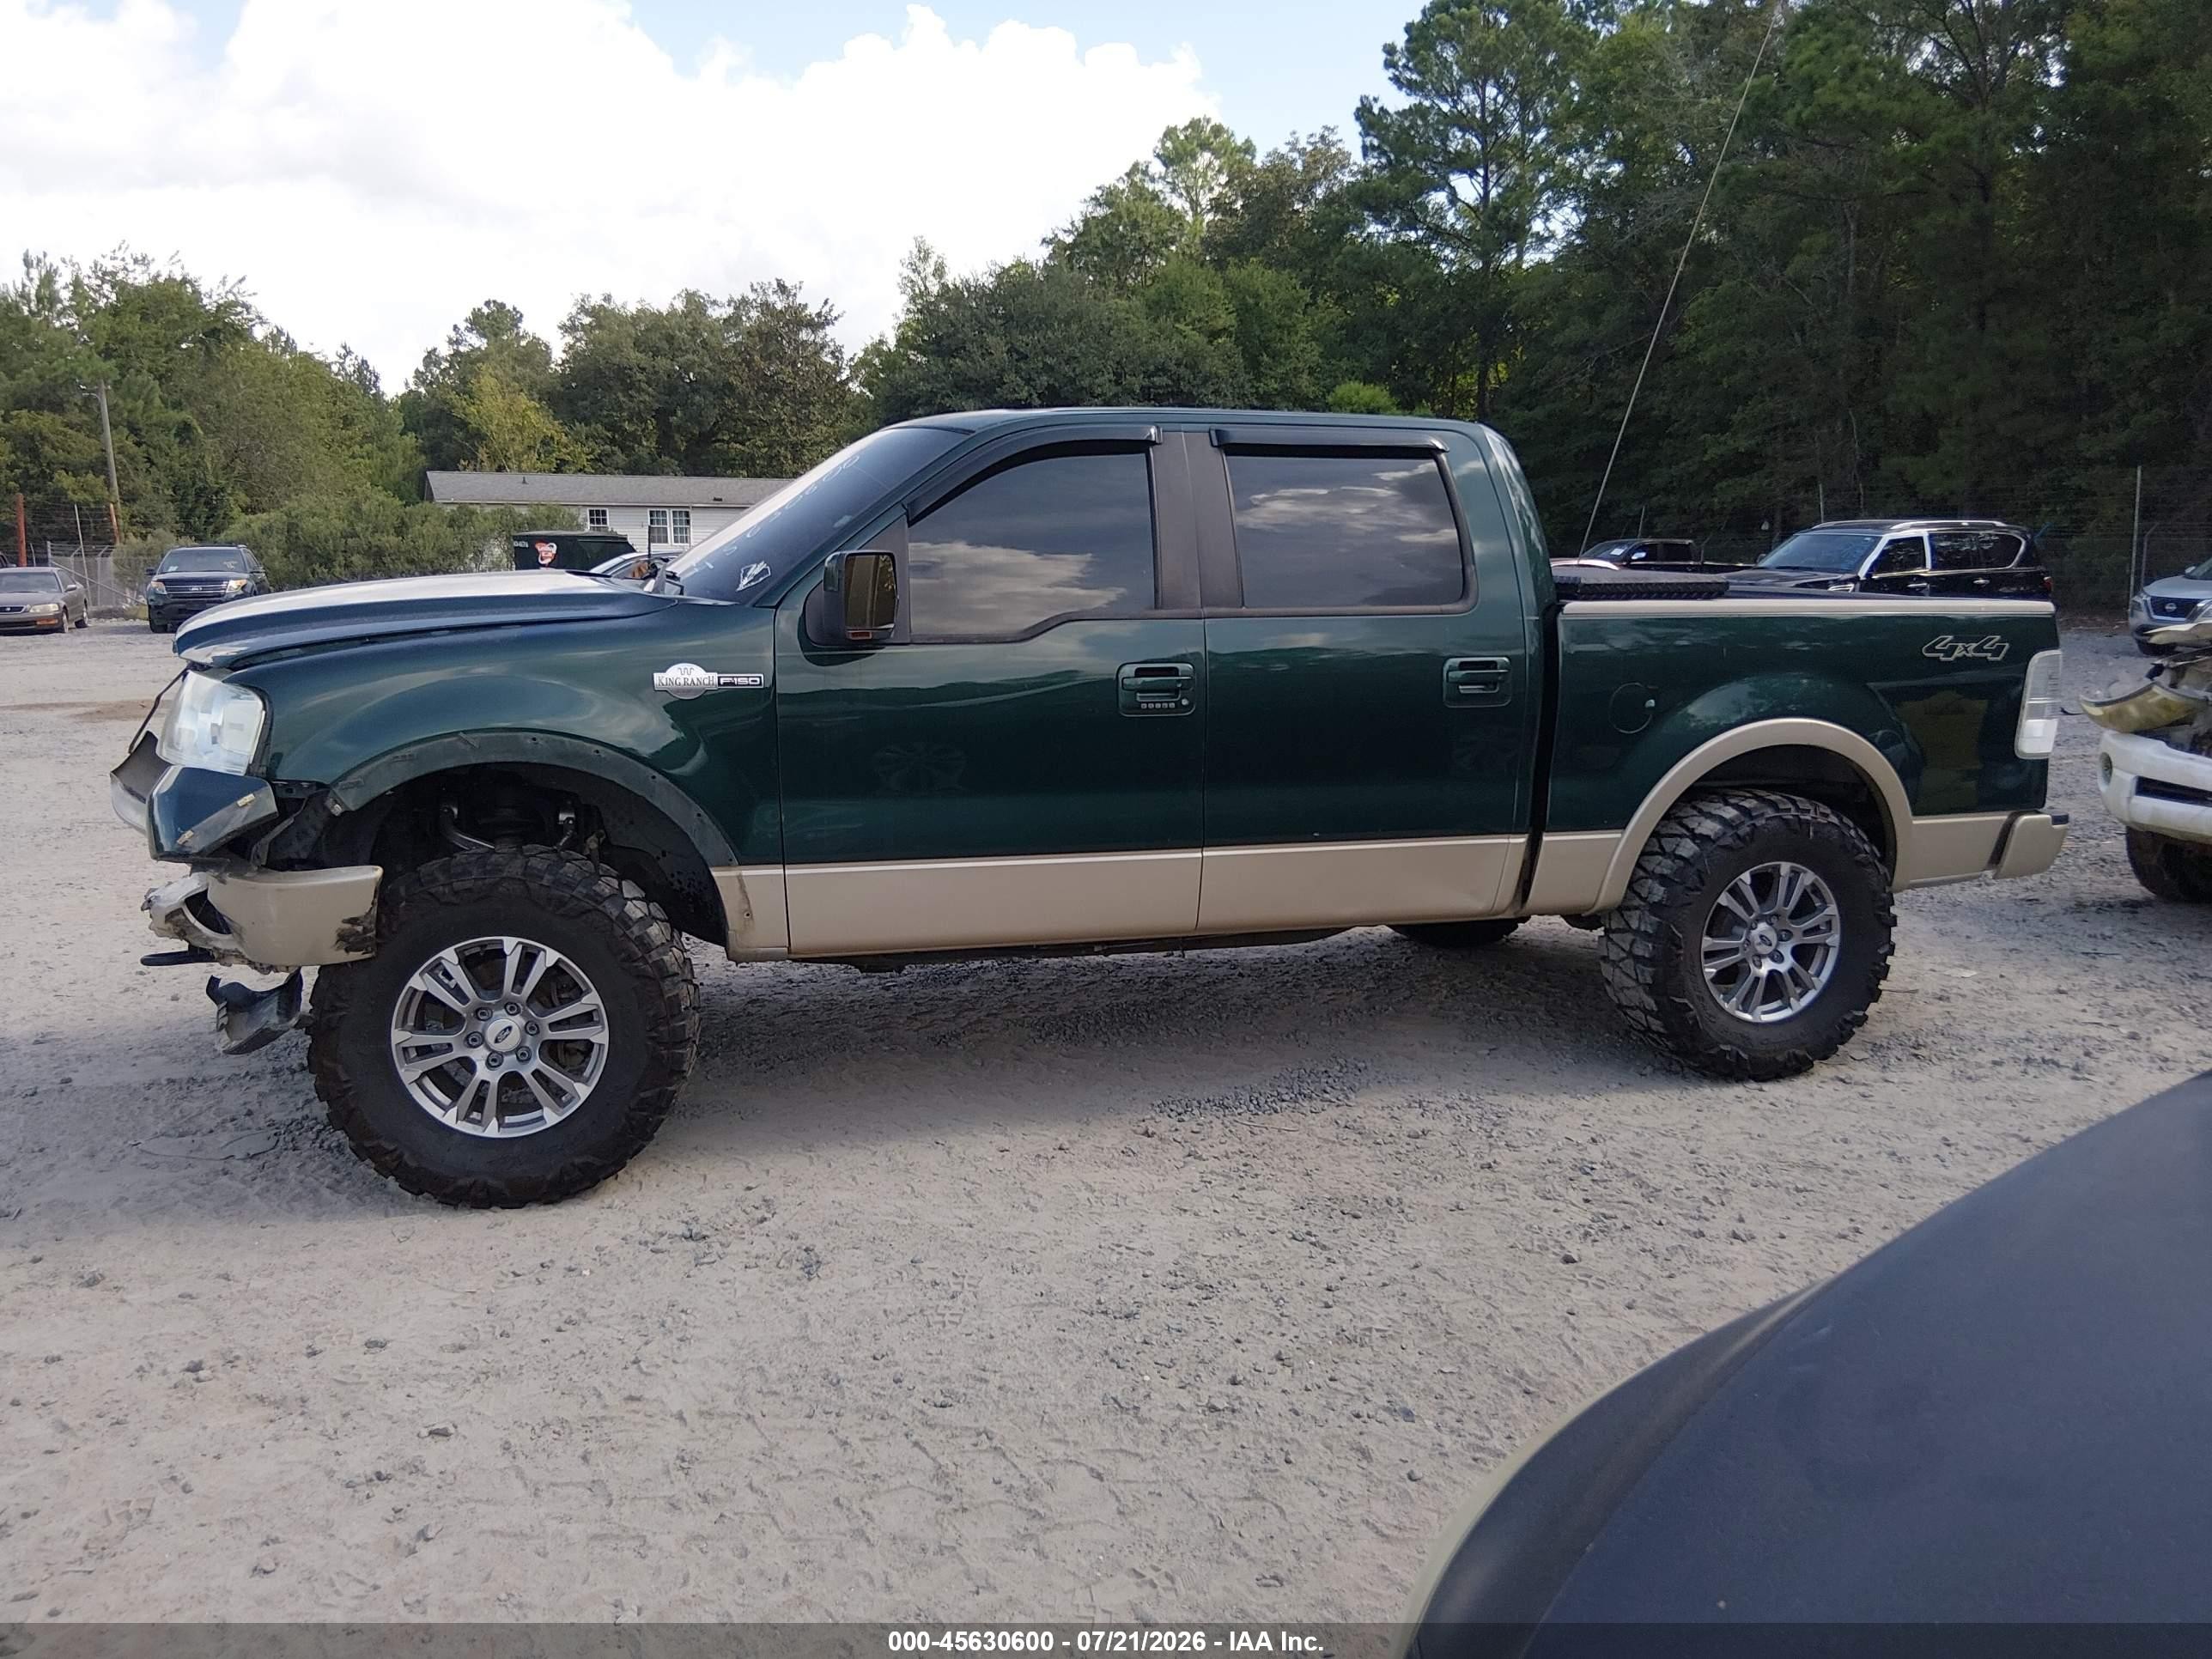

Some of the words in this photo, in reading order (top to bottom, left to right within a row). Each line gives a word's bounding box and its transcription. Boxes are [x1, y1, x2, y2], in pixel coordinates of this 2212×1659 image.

[1922, 635, 2010, 661] 4x4
[658, 677, 681, 687] KING
[684, 676, 715, 687] RANCH
